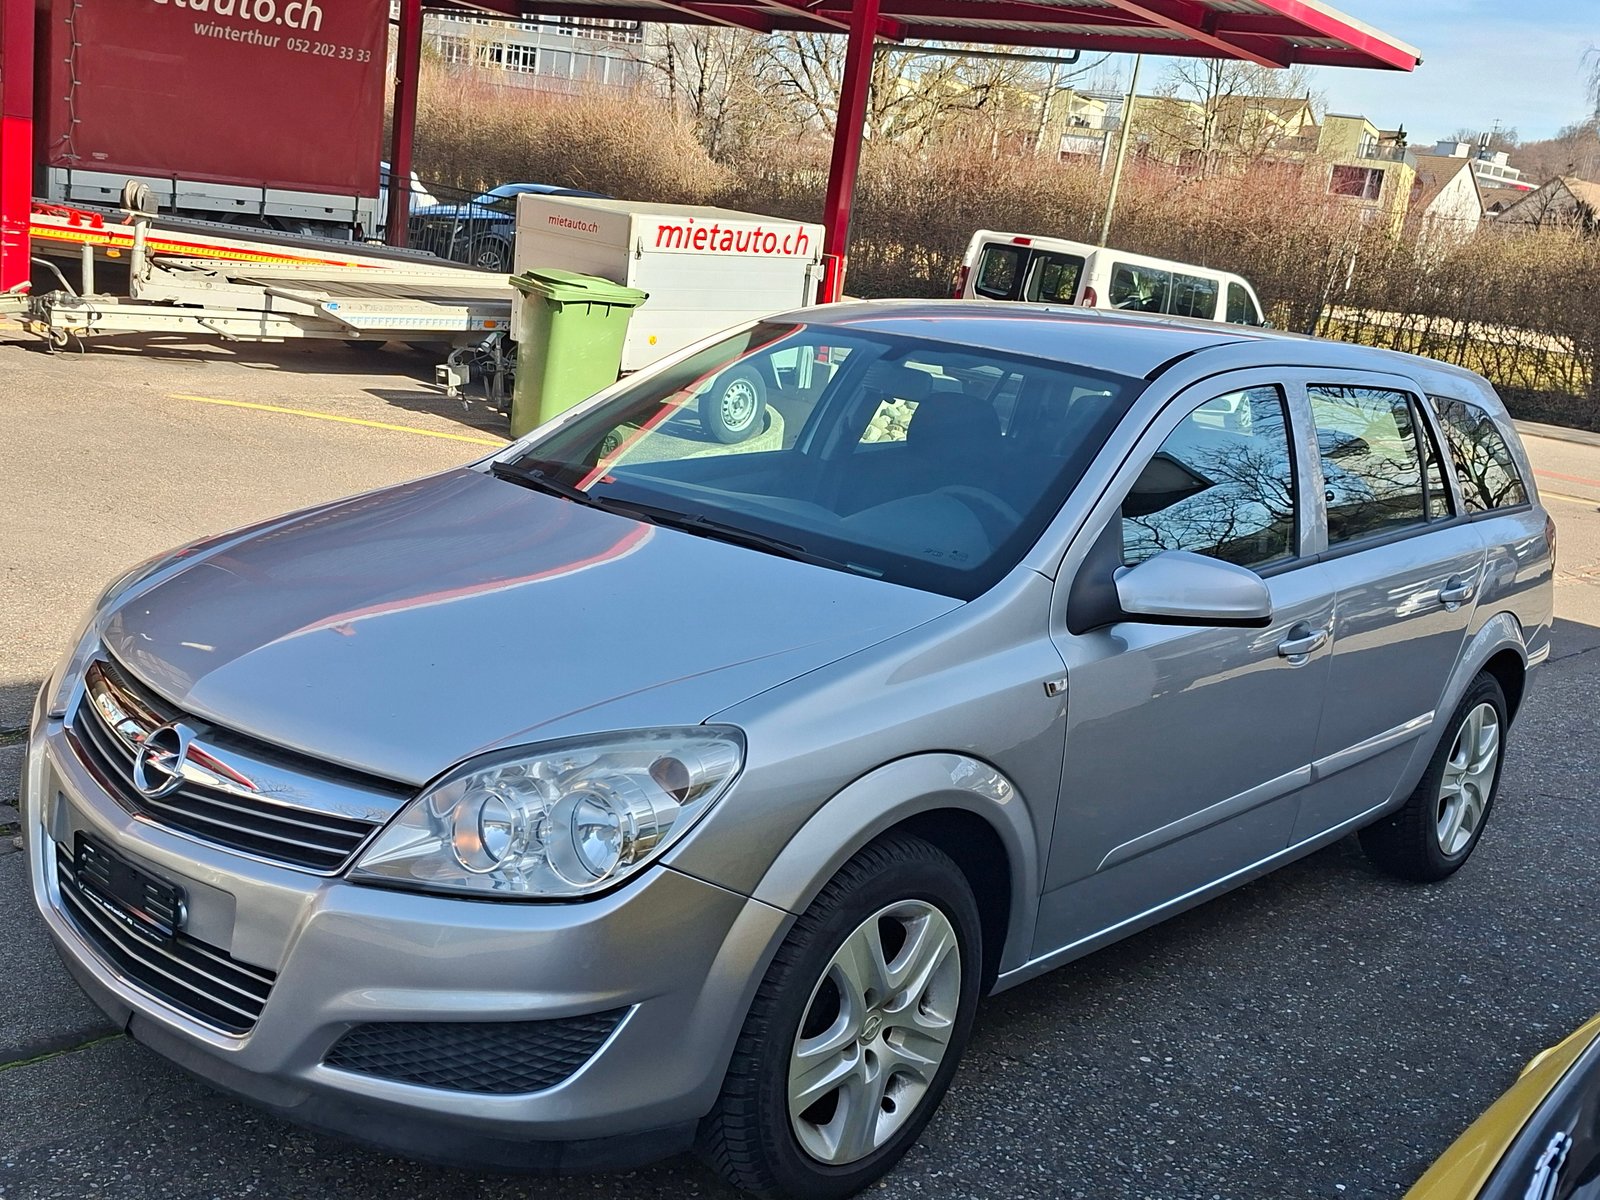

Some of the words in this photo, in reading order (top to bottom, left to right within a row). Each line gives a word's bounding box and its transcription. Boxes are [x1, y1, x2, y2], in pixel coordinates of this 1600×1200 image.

[154, 0, 324, 32] auto.ch
[193, 21, 281, 48] winterthur
[286, 37, 310, 53] 052
[312, 41, 336, 58] 202
[338, 46, 354, 60] 33
[356, 49, 372, 63] 33
[548, 214, 599, 233] mietauto.ch
[655, 217, 810, 256] mietauto.ch
